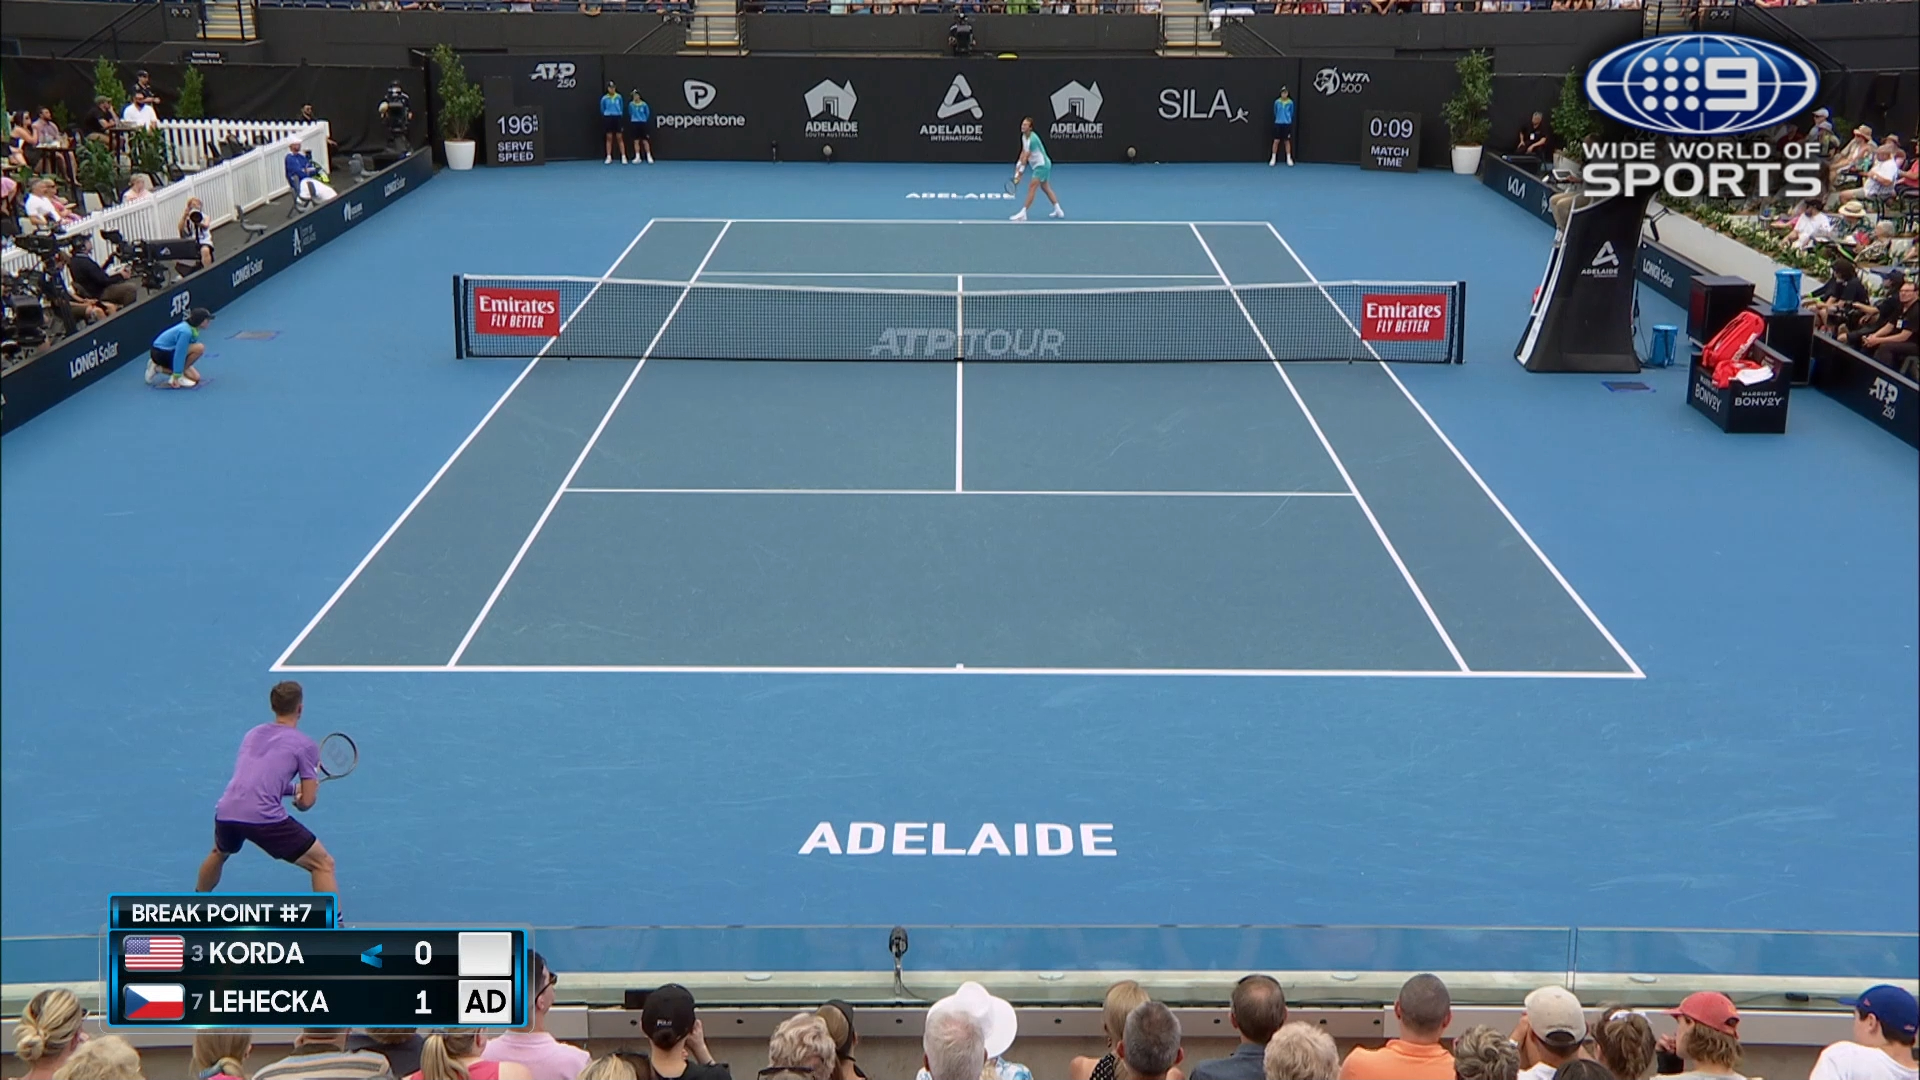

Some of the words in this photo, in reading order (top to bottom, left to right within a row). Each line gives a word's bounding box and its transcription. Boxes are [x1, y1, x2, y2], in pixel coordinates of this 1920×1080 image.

[530, 63, 576, 80] ATP
[1341, 72, 1370, 83] WTA
[557, 79, 577, 88] 250
[1341, 83, 1362, 93] 500
[1158, 89, 1232, 119] SILA
[497, 115, 533, 134] 196
[656, 113, 745, 128] pepperstone
[805, 121, 858, 132] ADELAIDE
[1370, 118, 1413, 138] 0:09
[920, 125, 982, 135] ADELAIDE
[1050, 123, 1103, 134] ADELAIDE
[498, 141, 534, 151] SERVE
[1371, 146, 1410, 157] MATCH
[498, 152, 534, 162] SPEED
[1376, 157, 1402, 167] TIME
[1508, 176, 1526, 199] KIA
[479, 295, 555, 314] Emirates
[1366, 301, 1442, 319] Emirates
[490, 313, 508, 327] FLY
[509, 314, 544, 329] BETTER
[1376, 320, 1393, 333] FLY
[1395, 320, 1430, 333] BETTER
[867, 328, 956, 356] ATP
[962, 328, 1065, 356] TOUR
[98, 342, 118, 364] Solar
[1868, 376, 1899, 404] ATP
[1695, 383, 1721, 413] BONVOY
[1735, 397, 1782, 406] BONVOY
[798, 821, 1118, 856] ADELAIDE
